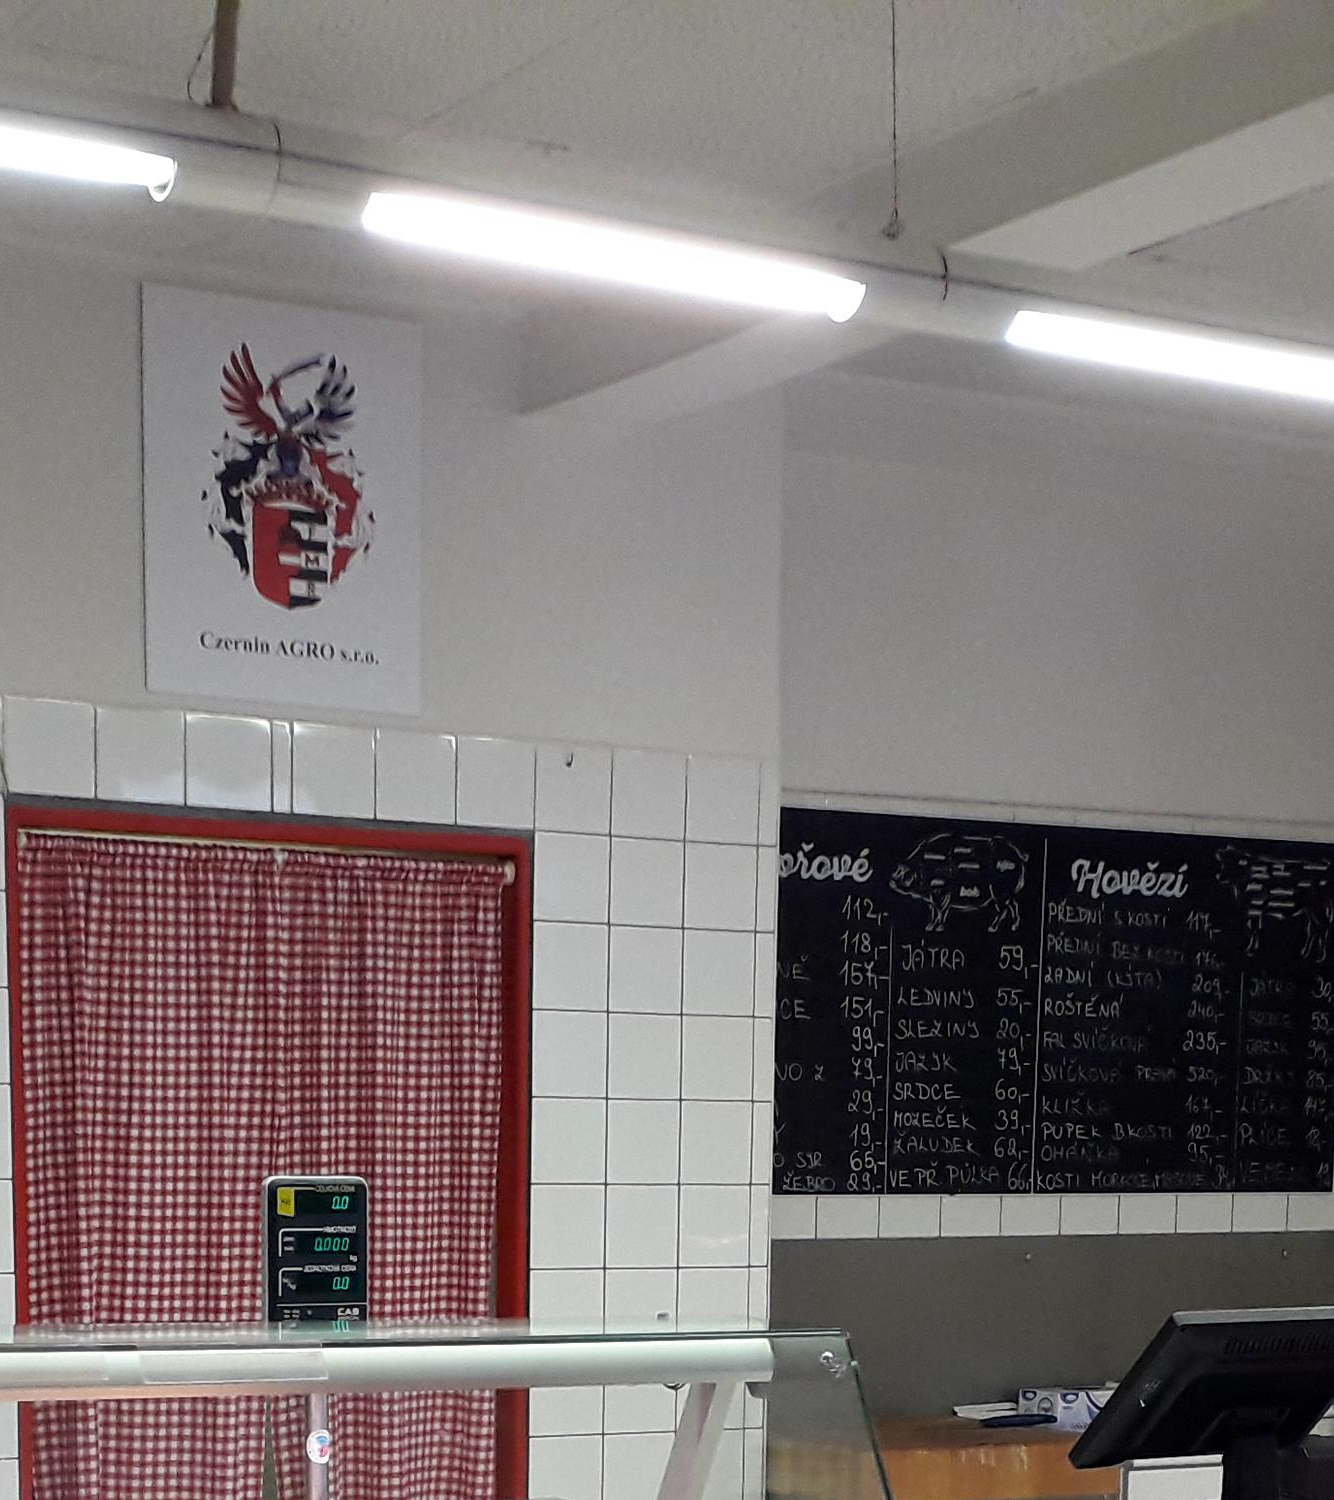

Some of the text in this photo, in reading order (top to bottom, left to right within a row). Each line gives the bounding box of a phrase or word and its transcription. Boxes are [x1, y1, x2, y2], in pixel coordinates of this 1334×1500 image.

[200, 631, 380, 666] Czernin AGRO s.r.o.
[1070, 857, 1190, 899] Hovězí
[901, 938, 1039, 979] JÁTRA 59,-
[897, 986, 1033, 1015] LEDVINY 55,-
[895, 1050, 957, 1073] JAZYK
[893, 1081, 961, 1101] SRDCE
[894, 1105, 978, 1131] MOZEČEK
[891, 1130, 979, 1156] ŽALUDEK
[331, 1195, 349, 1210] 0.0
[314, 1237, 350, 1251] 0.000
[332, 1276, 350, 1290] 0.0
[337, 1307, 360, 1316] CAS
